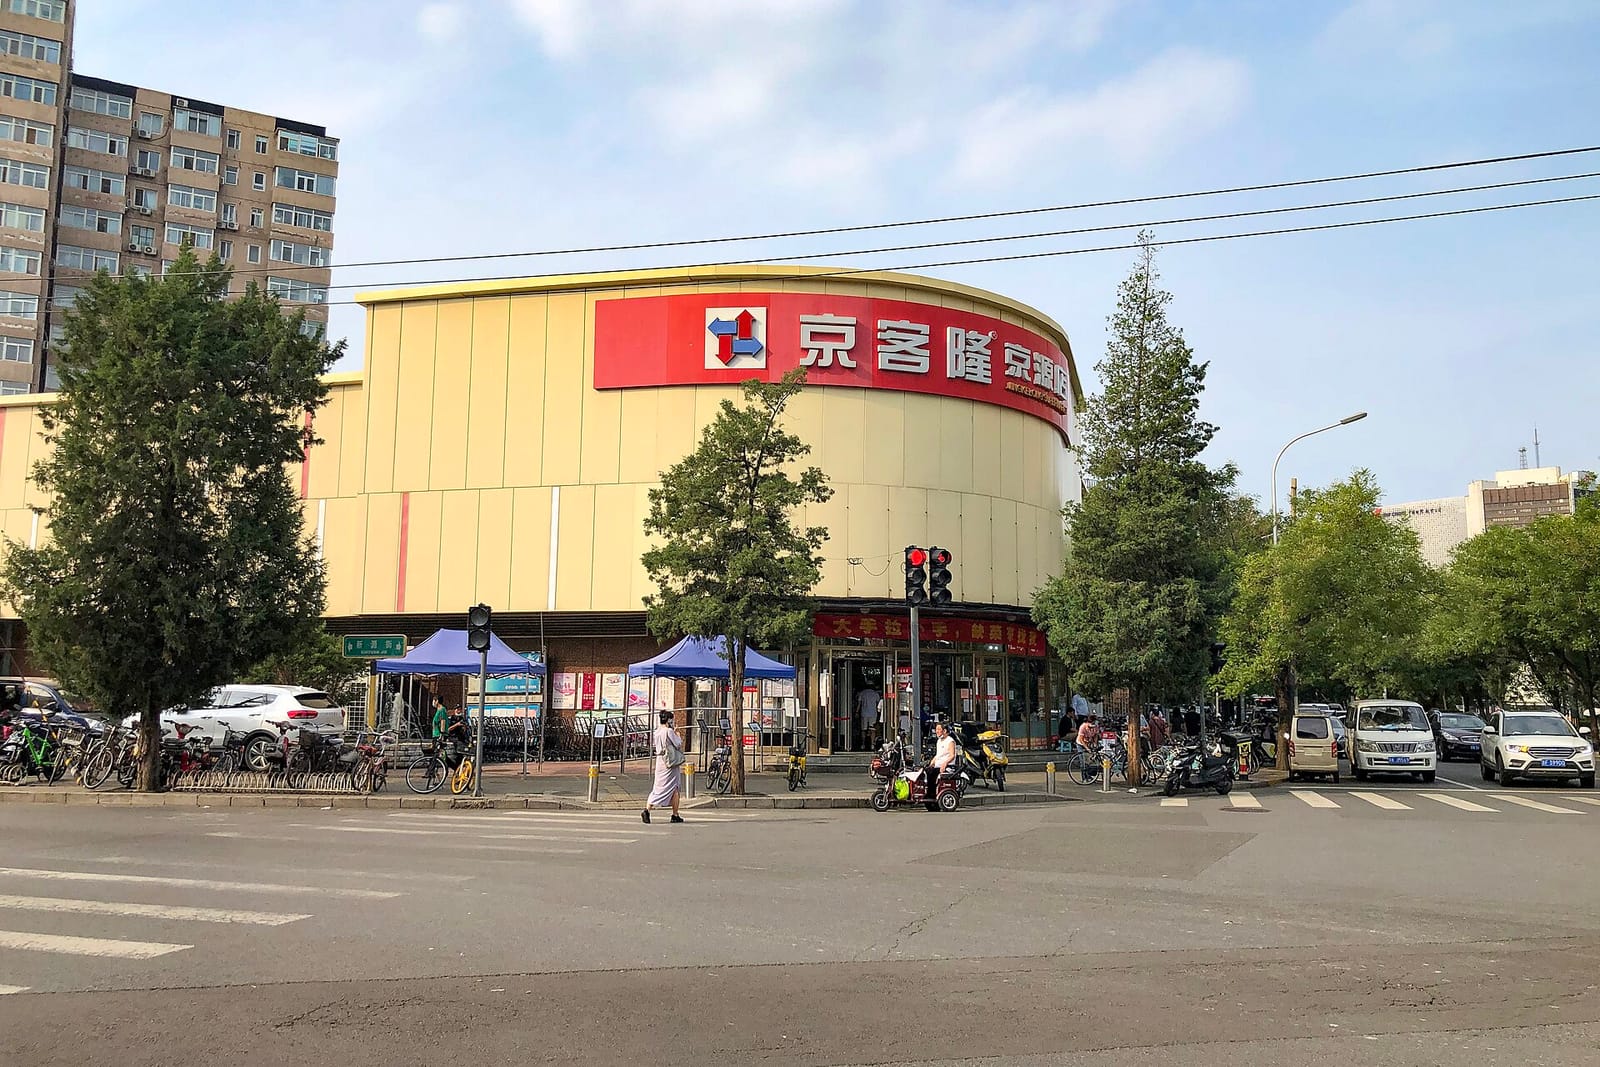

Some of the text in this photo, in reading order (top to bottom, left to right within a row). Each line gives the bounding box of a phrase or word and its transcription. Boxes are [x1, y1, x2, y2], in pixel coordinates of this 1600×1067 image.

[799, 313, 1069, 401] 京客隆 京源店
